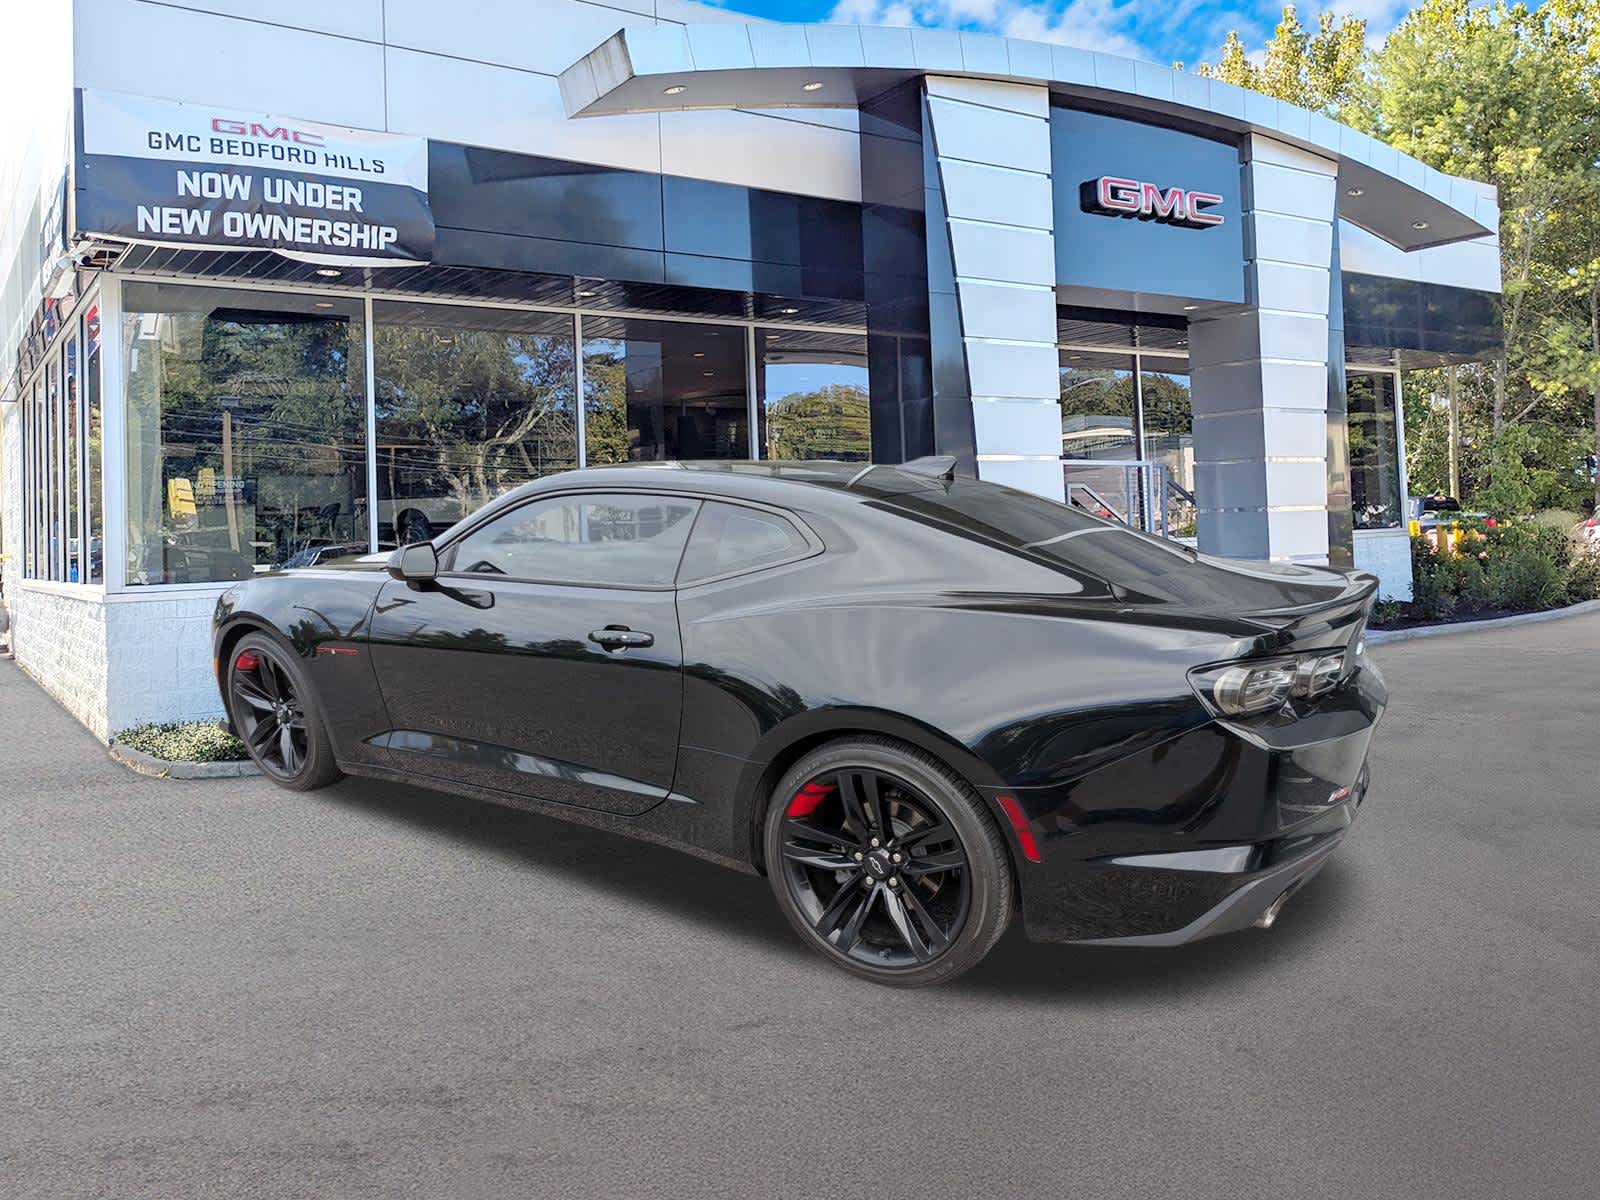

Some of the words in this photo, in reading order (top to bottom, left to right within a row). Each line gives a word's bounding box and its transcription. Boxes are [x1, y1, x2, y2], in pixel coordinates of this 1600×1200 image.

[148, 131, 201, 152] GMC
[210, 137, 317, 165] BEDFORD
[324, 153, 385, 174] HILLS
[211, 118, 326, 148] GMC
[177, 170, 252, 201] NOW
[263, 177, 363, 213] UNDER
[1097, 175, 1225, 225] GMC
[137, 205, 211, 236] NEW
[223, 211, 398, 250] OWNERSHIP
